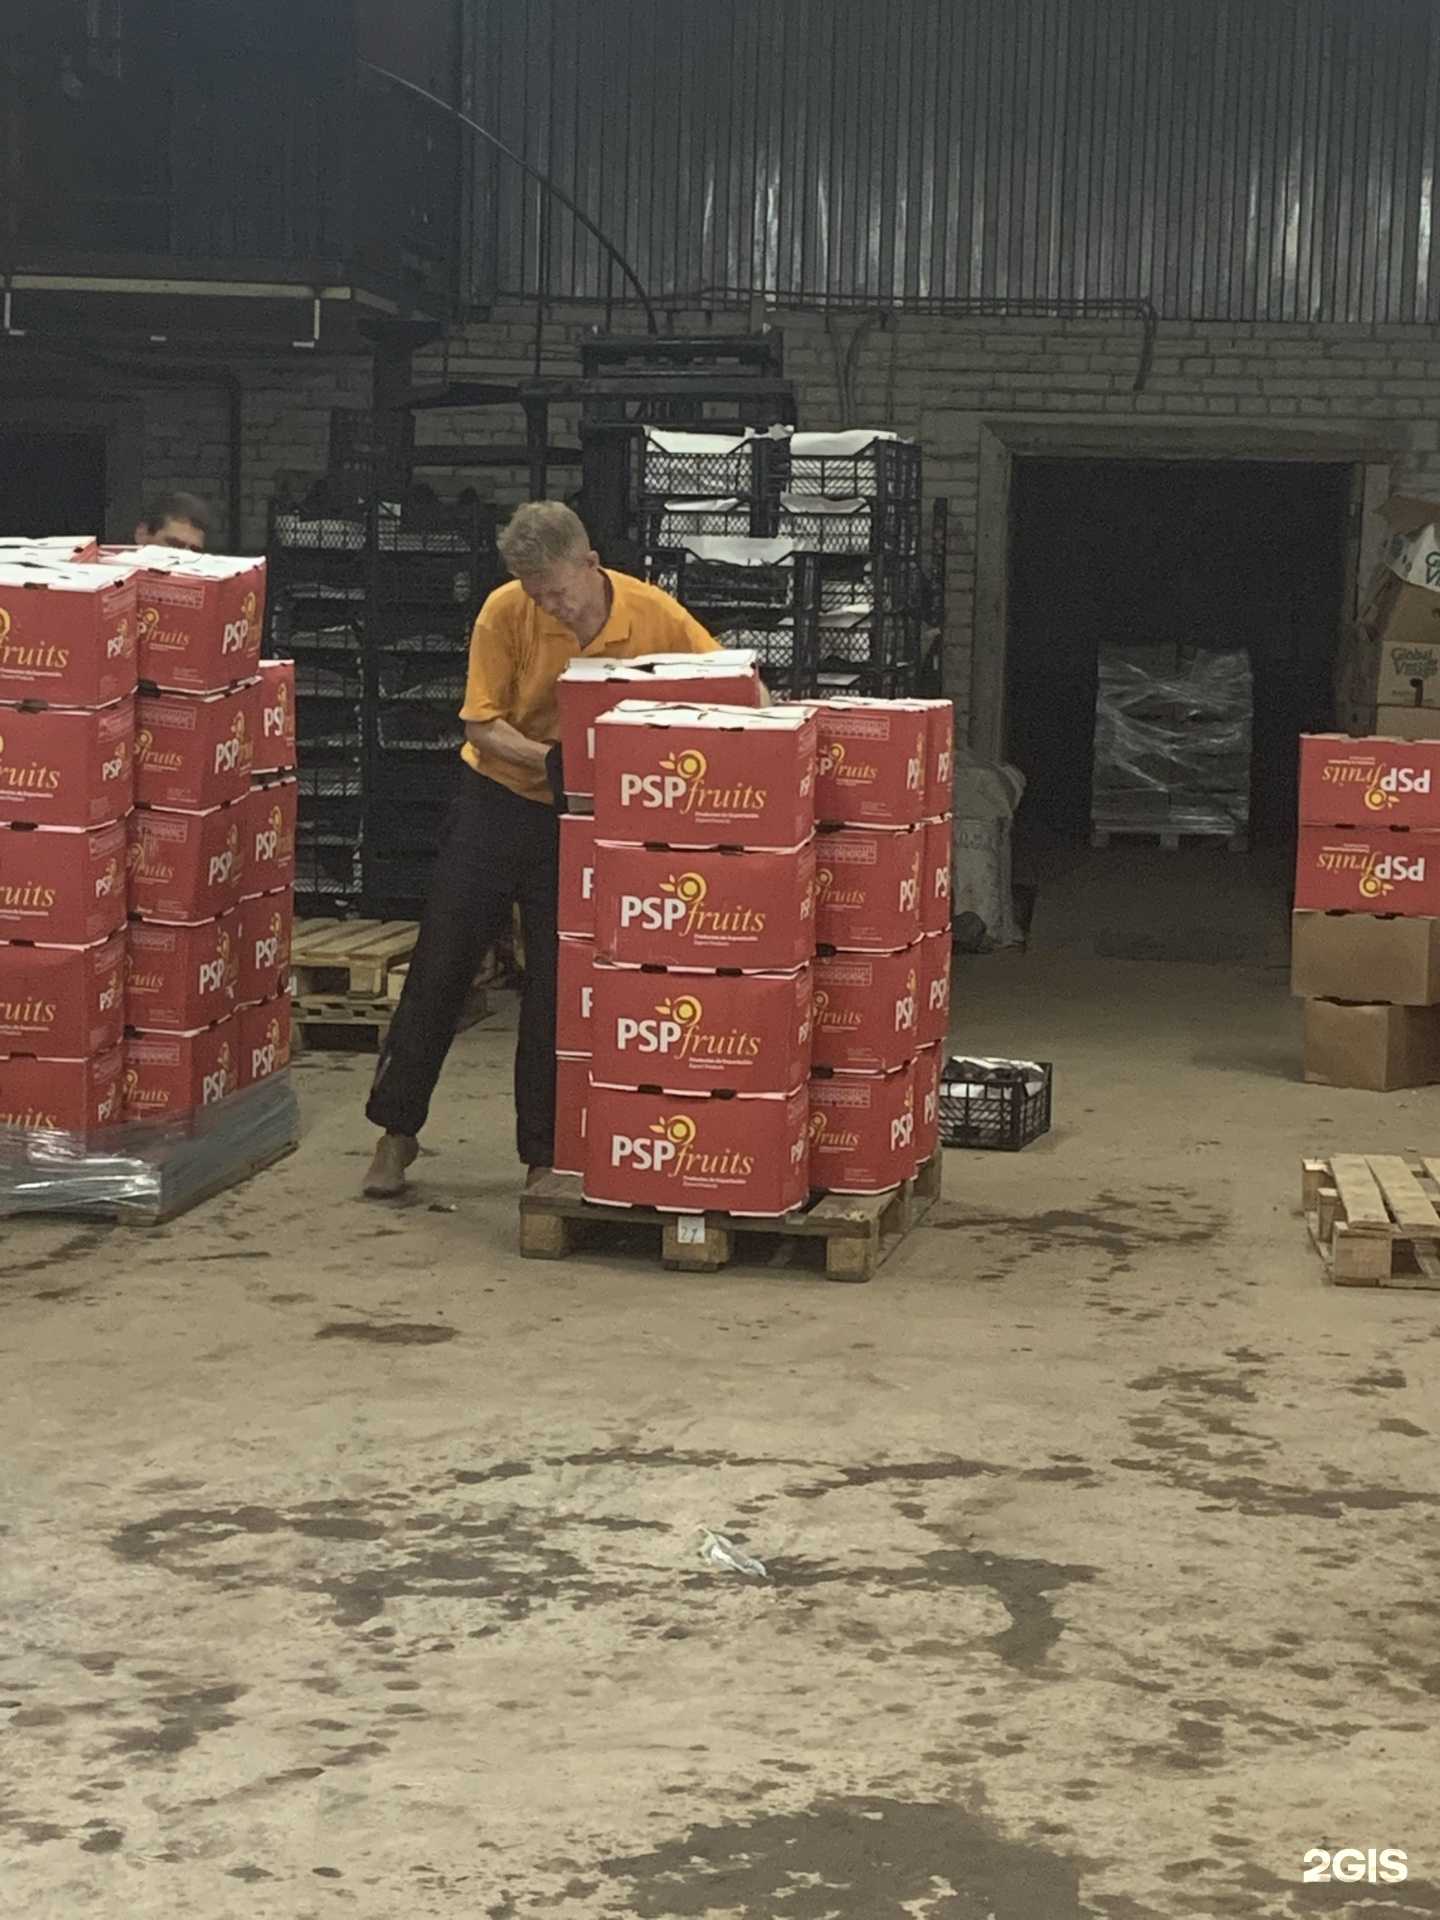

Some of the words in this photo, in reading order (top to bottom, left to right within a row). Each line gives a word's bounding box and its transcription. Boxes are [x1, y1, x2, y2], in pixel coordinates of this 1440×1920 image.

[222, 619, 248, 655] PSP
[214, 738, 240, 774] PSP
[1322, 762, 1387, 787] fruits
[1380, 767, 1431, 794] PSP
[621, 773, 687, 809] PSP
[679, 779, 767, 815] fruits
[256, 831, 277, 862] PSP
[1316, 850, 1382, 875] fruits
[1375, 854, 1425, 882] PSP
[620, 894, 686, 931] PSP
[678, 902, 766, 937] fruits
[199, 958, 225, 995] PSP
[617, 1017, 682, 1054] PSP
[674, 1025, 761, 1060] fruits
[611, 1134, 676, 1172] PSP
[668, 1143, 755, 1178] fruits
